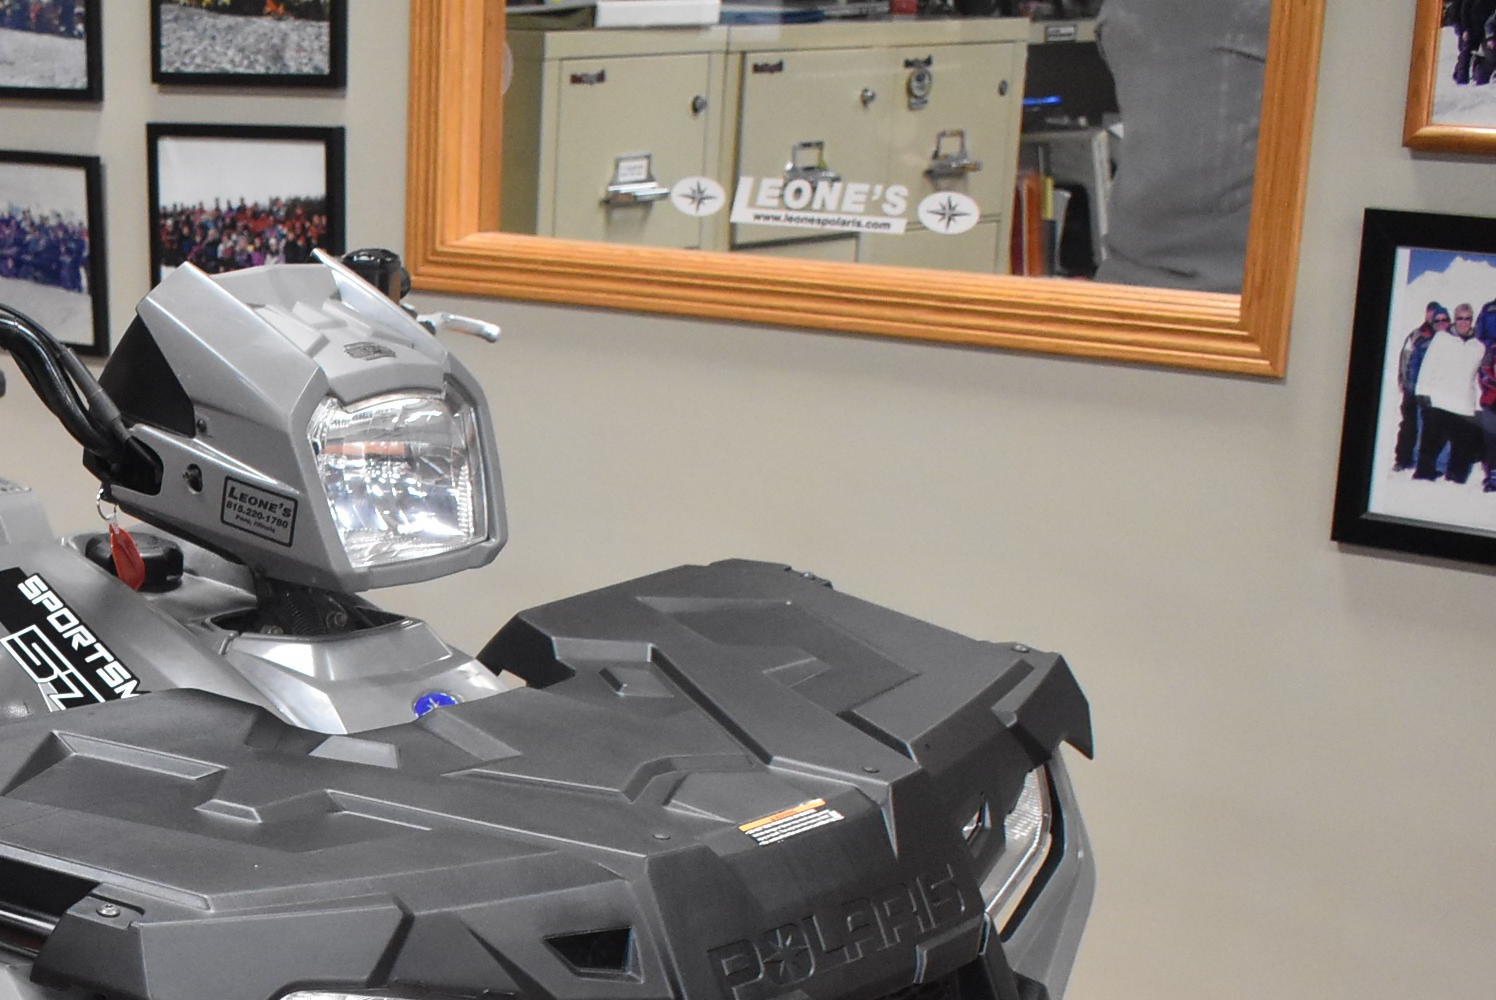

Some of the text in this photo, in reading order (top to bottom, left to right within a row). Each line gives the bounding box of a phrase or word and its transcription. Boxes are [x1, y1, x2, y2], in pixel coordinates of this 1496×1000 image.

[730, 175, 909, 221] LEONE'S
[753, 213, 891, 230] www.leonespolaris.com
[227, 486, 292, 518] LEONE'S
